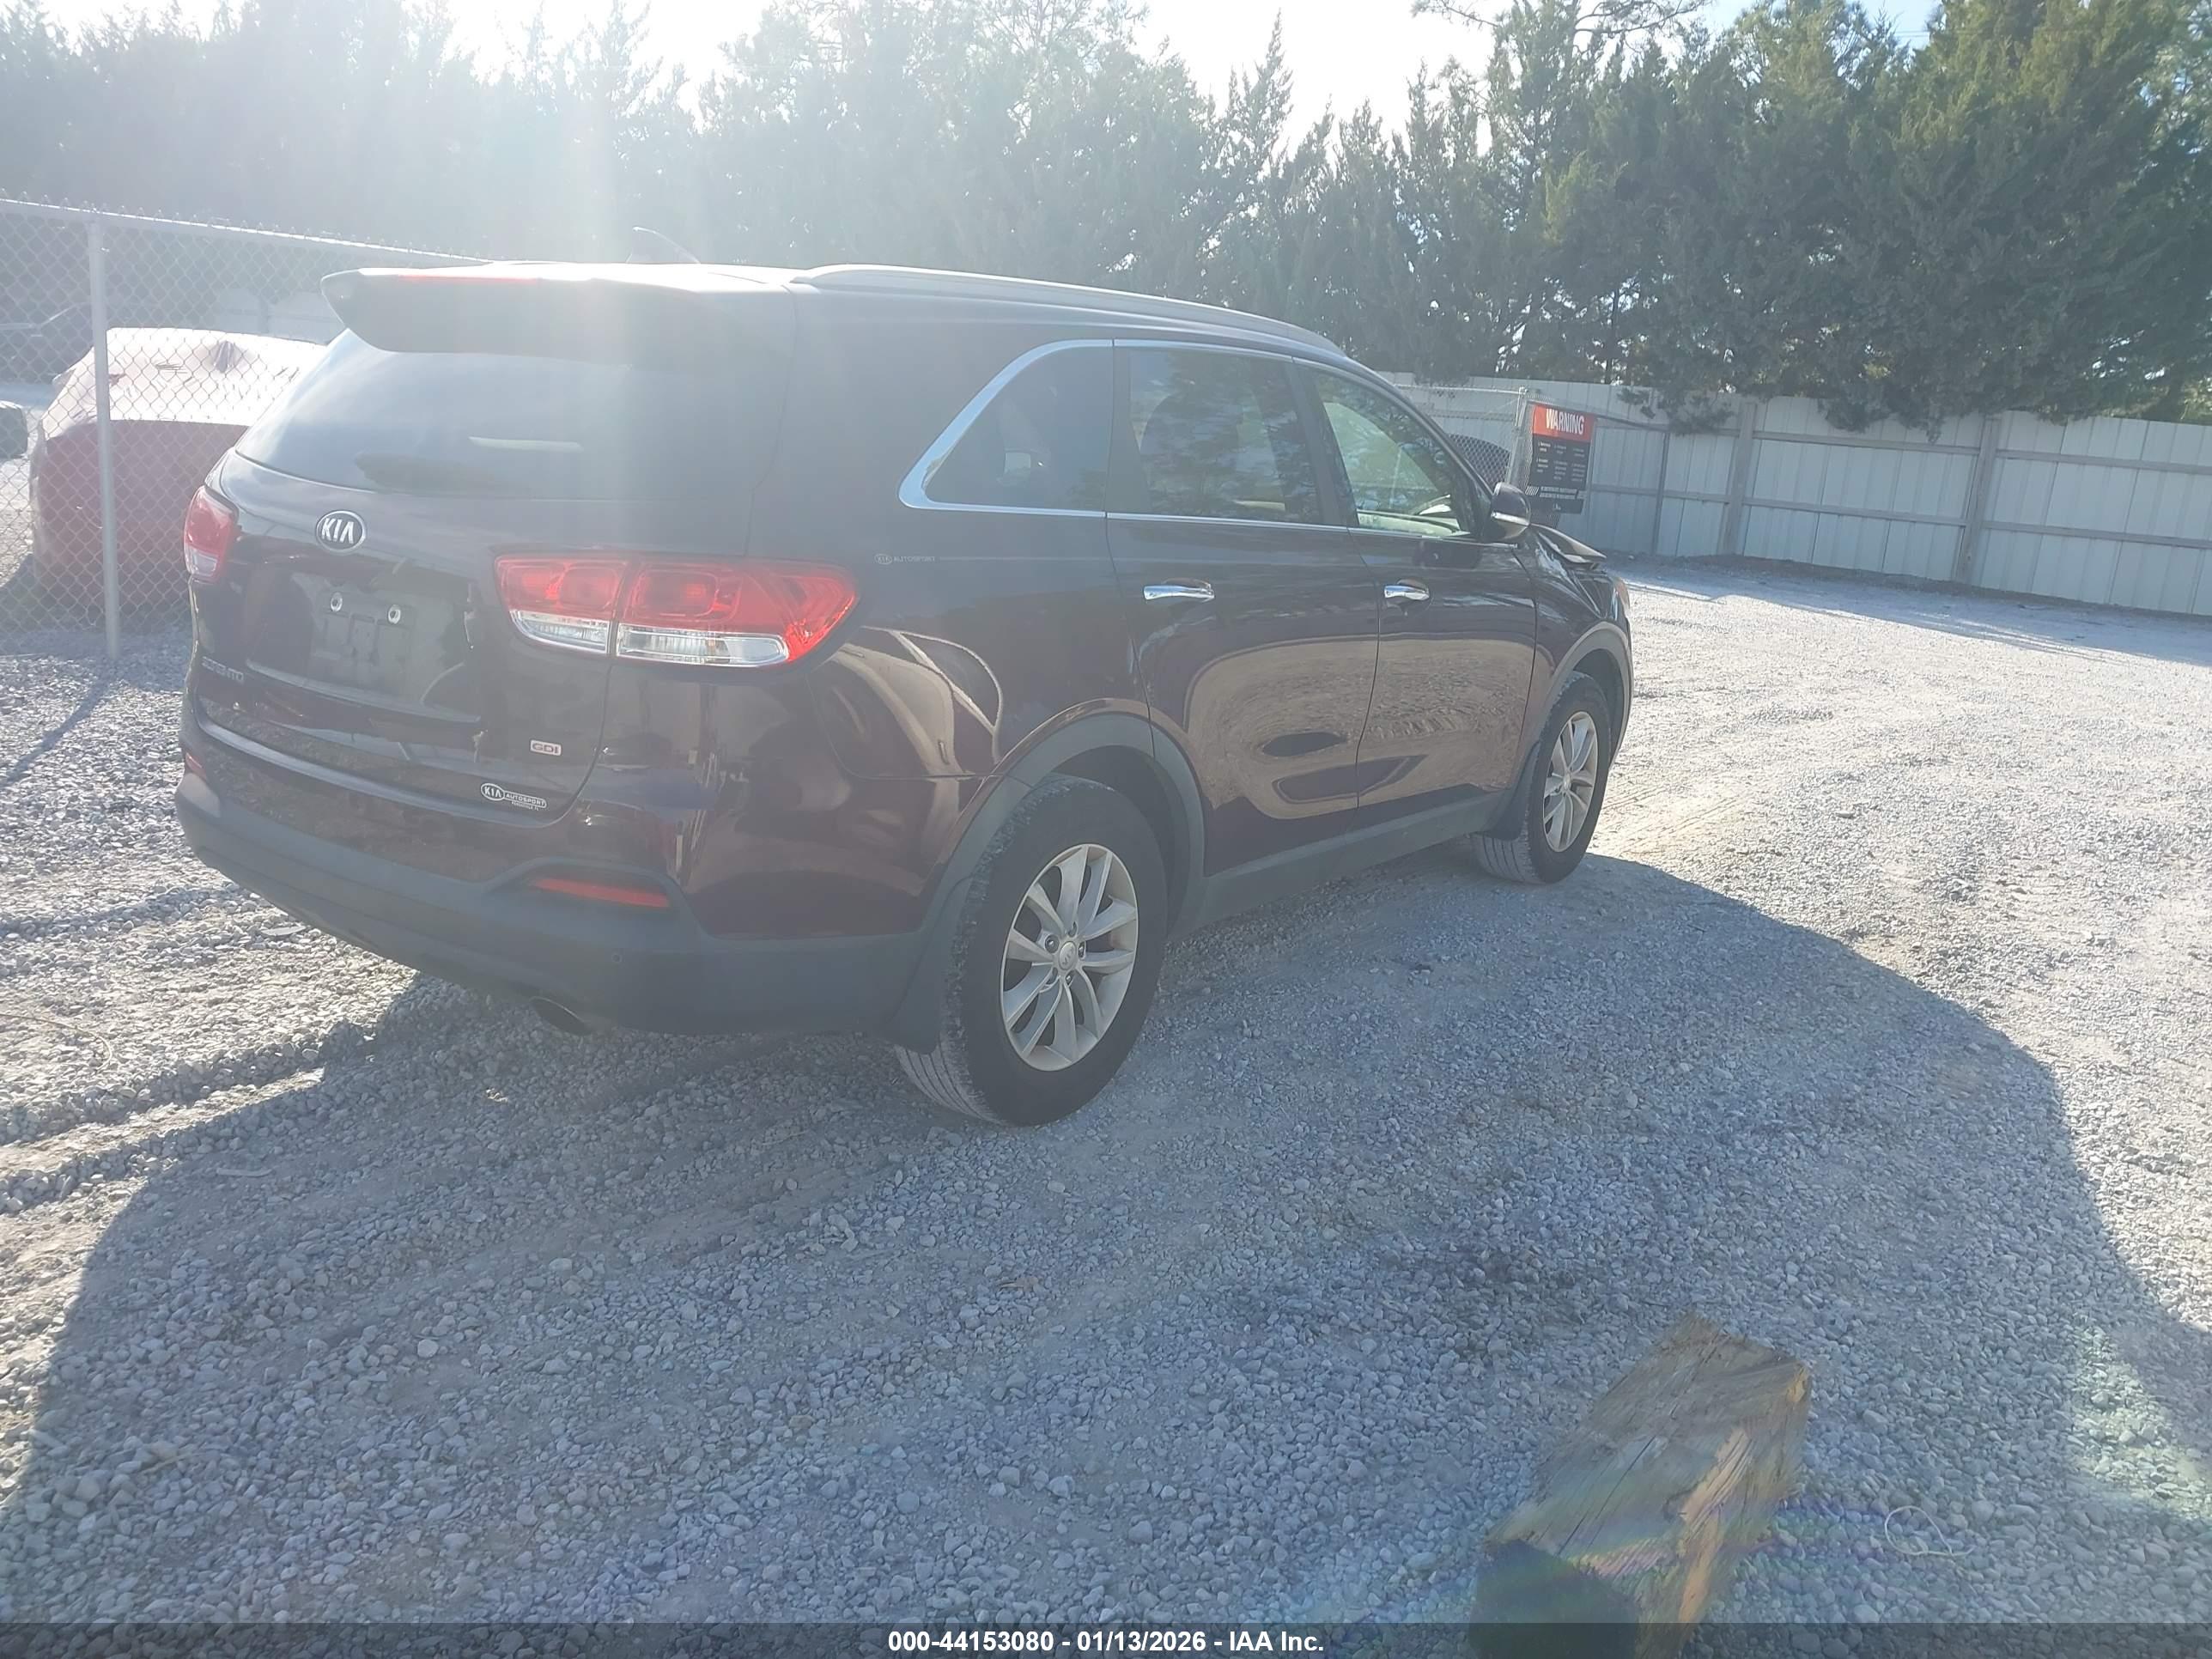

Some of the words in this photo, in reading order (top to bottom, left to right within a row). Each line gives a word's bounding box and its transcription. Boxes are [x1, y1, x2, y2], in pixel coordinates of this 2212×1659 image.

[1546, 408, 1584, 435] WARNING
[321, 518, 355, 544] KIA
[532, 743, 558, 753] GDI
[483, 786, 502, 798] KIA
[506, 793, 544, 806] AUTOSPORT
